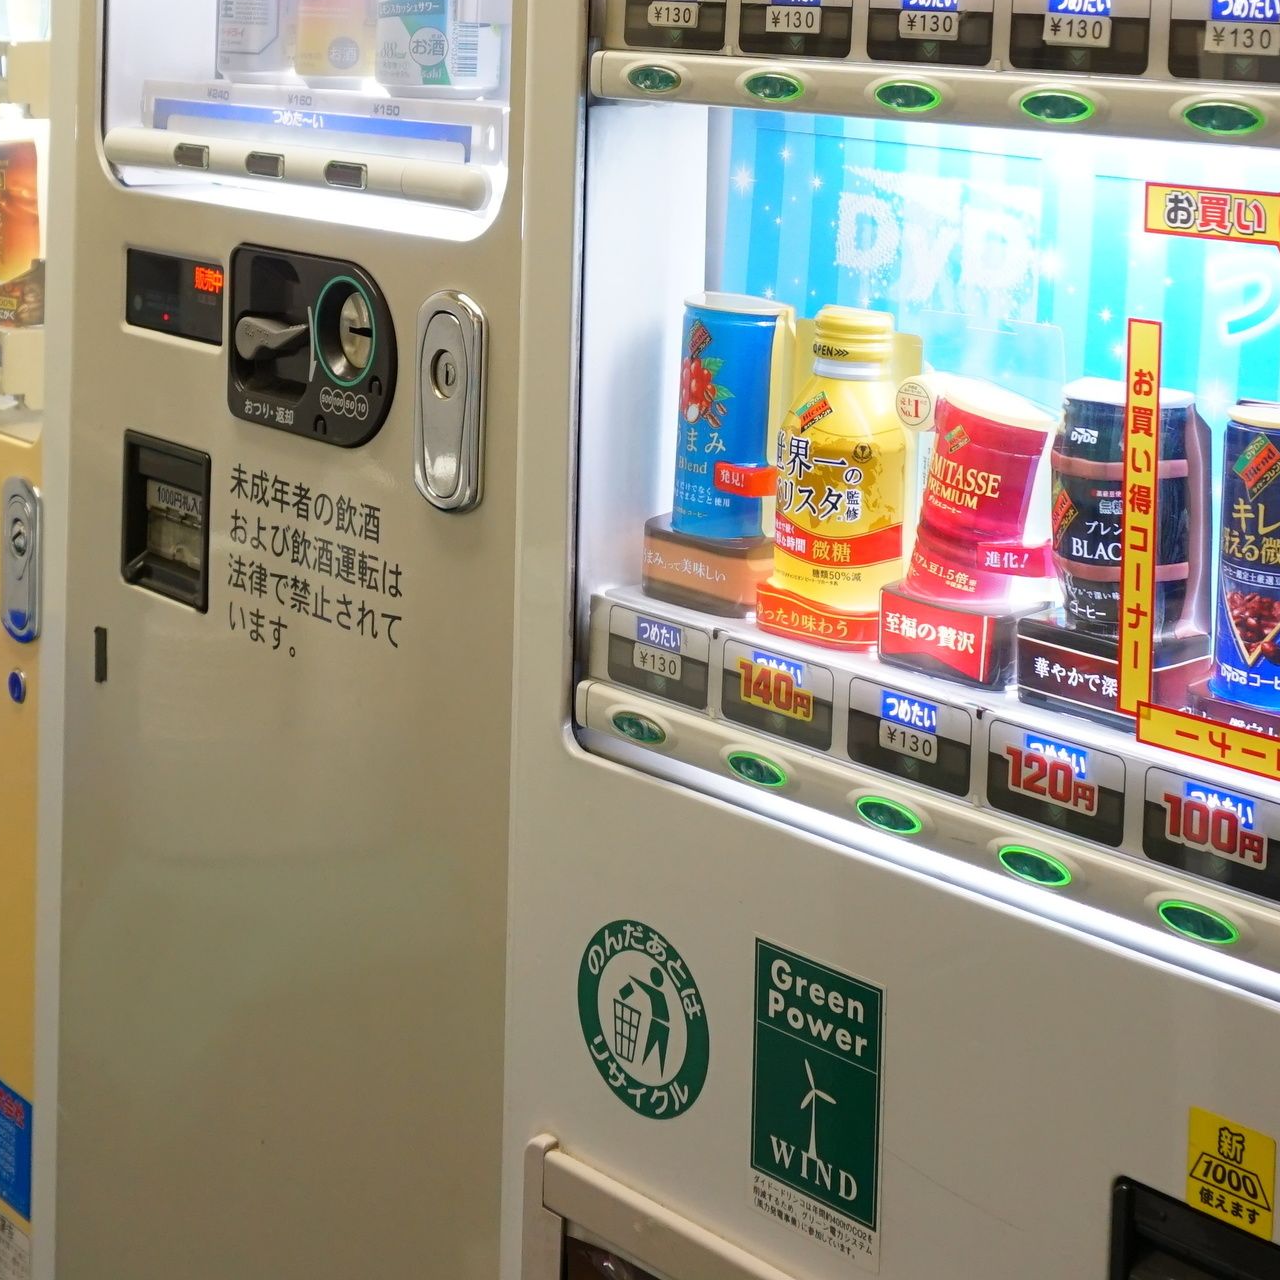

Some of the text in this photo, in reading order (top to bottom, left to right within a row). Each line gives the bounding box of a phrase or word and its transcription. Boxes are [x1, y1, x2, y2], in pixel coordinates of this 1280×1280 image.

[653, 5, 692, 24] ¥130
[770, 9, 815, 29] ¥130
[905, 13, 954, 34] ¥130
[1050, 17, 1104, 41] ¥130
[412, 38, 445, 57] お酒
[1212, 26, 1272, 50] ¥130
[373, 104, 400, 116] ¥150
[1163, 190, 1268, 235] お買い
[194, 267, 223, 294] 販売中
[812, 343, 834, 357] OPEN
[244, 398, 295, 425] おつり・返却
[1070, 426, 1099, 445] DyDo
[720, 468, 745, 488] 発見!
[1244, 449, 1277, 483] Blend
[230, 463, 380, 544] 未成年者の飲酒
[1126, 368, 1155, 670] お買い得コーナー
[229, 508, 403, 599] および飲酒運転は
[812, 539, 851, 564] 微糖
[984, 550, 1029, 569] 進化!
[812, 568, 862, 582] 糖類50%減
[227, 552, 403, 649] 法律で禁止されて
[1070, 600, 1107, 619] コーヒー
[228, 601, 296, 659] います。
[639, 620, 681, 650] つめたい
[756, 600, 849, 638] ゆったり味わう
[884, 609, 976, 656] 至福の贅沢
[639, 652, 677, 677] ¥130
[739, 659, 813, 719] 140円
[886, 697, 937, 728] つめたい
[886, 725, 932, 757] ¥130
[1006, 745, 1096, 812] 120円
[1163, 792, 1264, 864] 100円
[587, 922, 702, 1020] のんだあとは
[770, 958, 866, 1025] Green
[767, 987, 868, 1058] Power
[590, 1033, 689, 1116] リサイクル
[1218, 1126, 1246, 1165] 新
[770, 1134, 858, 1204] WIND
[1201, 1158, 1259, 1201] 1000
[1198, 1185, 1261, 1226] 使えます
